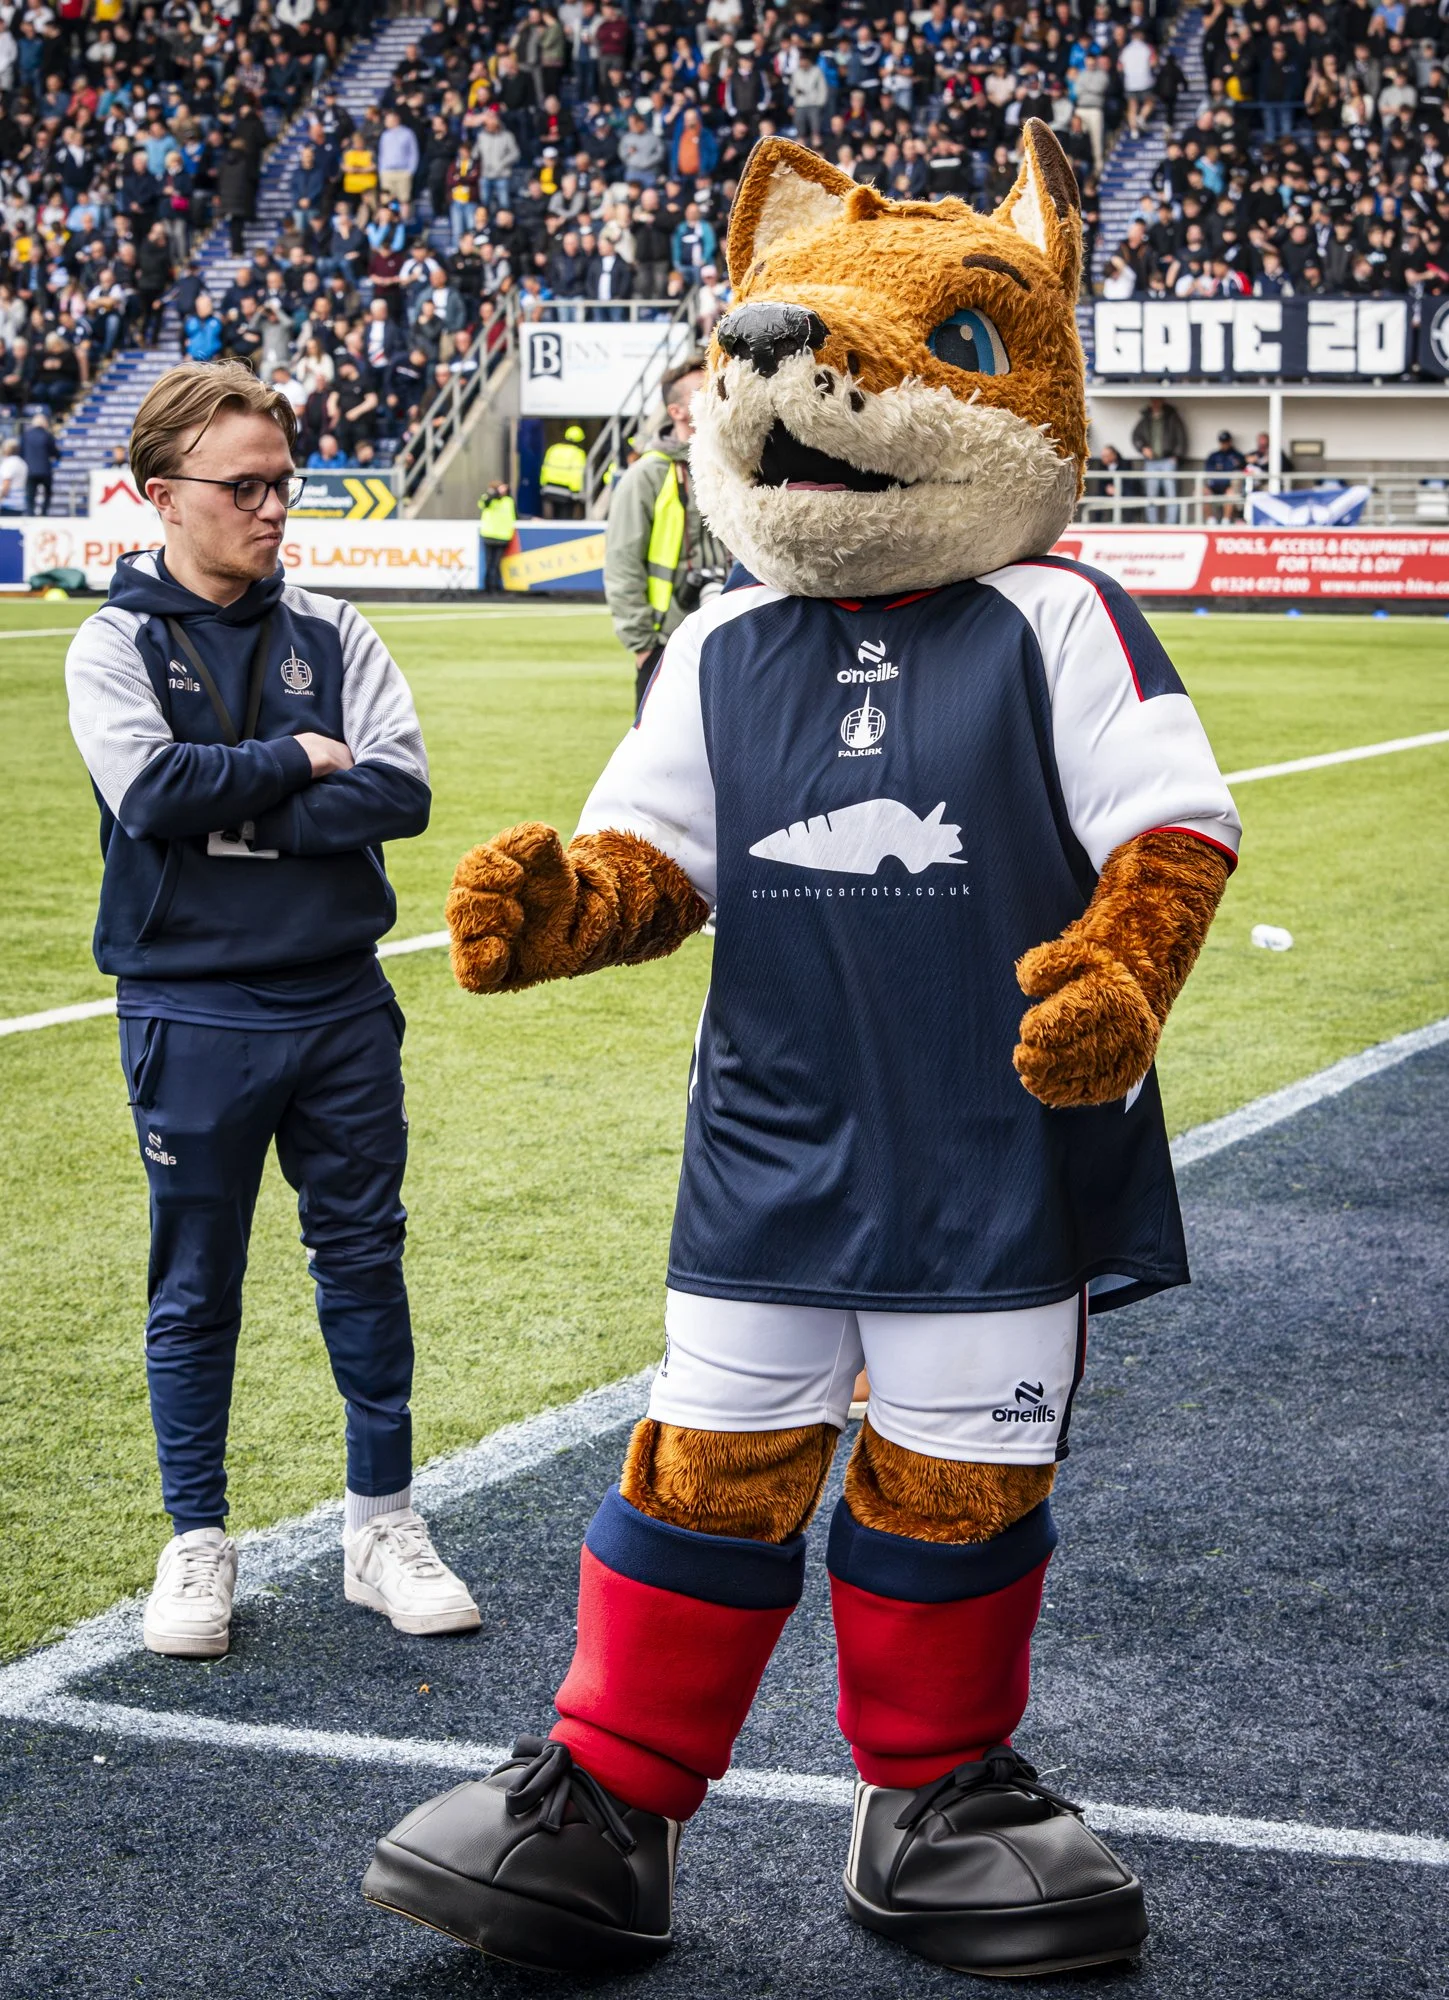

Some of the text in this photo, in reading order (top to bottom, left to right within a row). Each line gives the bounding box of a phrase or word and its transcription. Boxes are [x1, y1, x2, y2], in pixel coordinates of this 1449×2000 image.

[1094, 300, 1406, 374] GATE 20
[1269, 538, 1325, 555] ACCESS
[1327, 539, 1339, 555] &
[1340, 539, 1429, 556] EQUIPMENT
[310, 546, 466, 568] LADYBANK
[1276, 556, 1404, 573] FOR TRADE & DIY
[1320, 578, 1449, 594] www.moore-hire.co
[837, 662, 899, 683] o'neills
[838, 747, 882, 757] FALKIRK
[752, 884, 970, 899] crunchycarrots.co.uk
[992, 1404, 1056, 1423] o'neills
